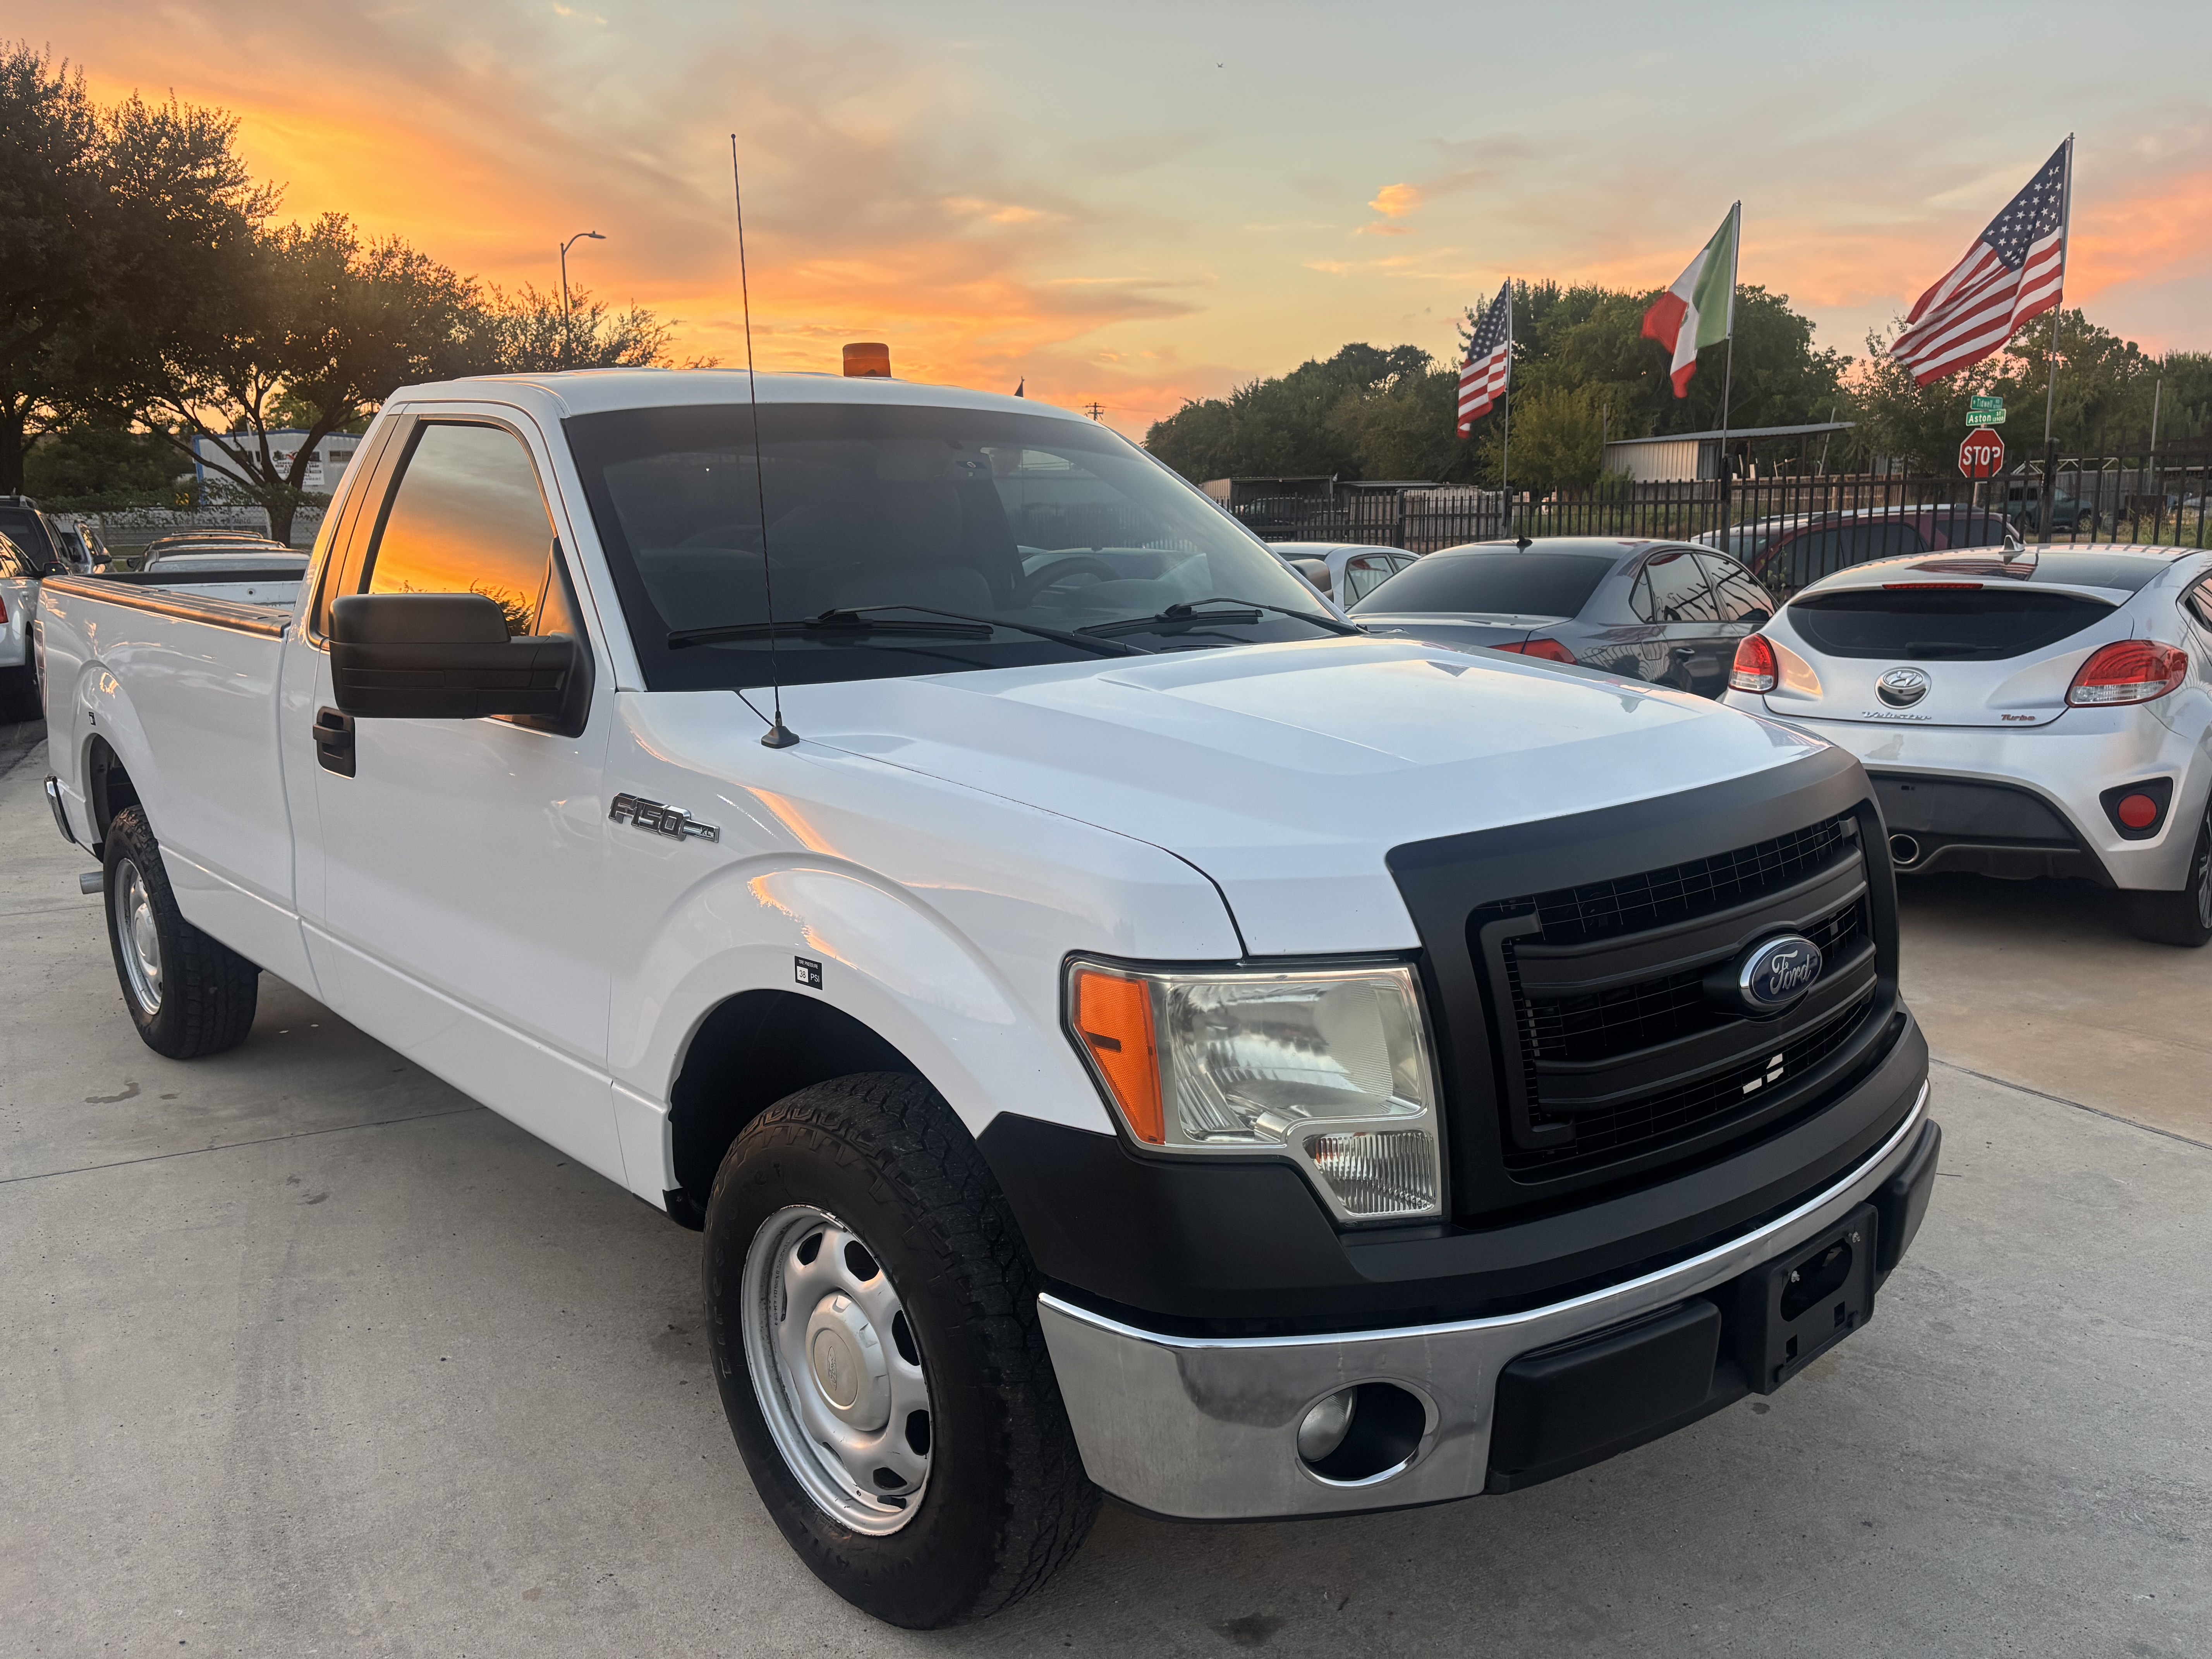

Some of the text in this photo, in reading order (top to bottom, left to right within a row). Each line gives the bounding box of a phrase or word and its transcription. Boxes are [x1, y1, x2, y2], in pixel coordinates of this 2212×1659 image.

[1968, 414, 1991, 423] Aston
[1963, 446, 2001, 465] STOP
[701, 827, 711, 836] XL
[799, 970, 820, 982] 38 PSI
[1770, 950, 1812, 994] Ford
